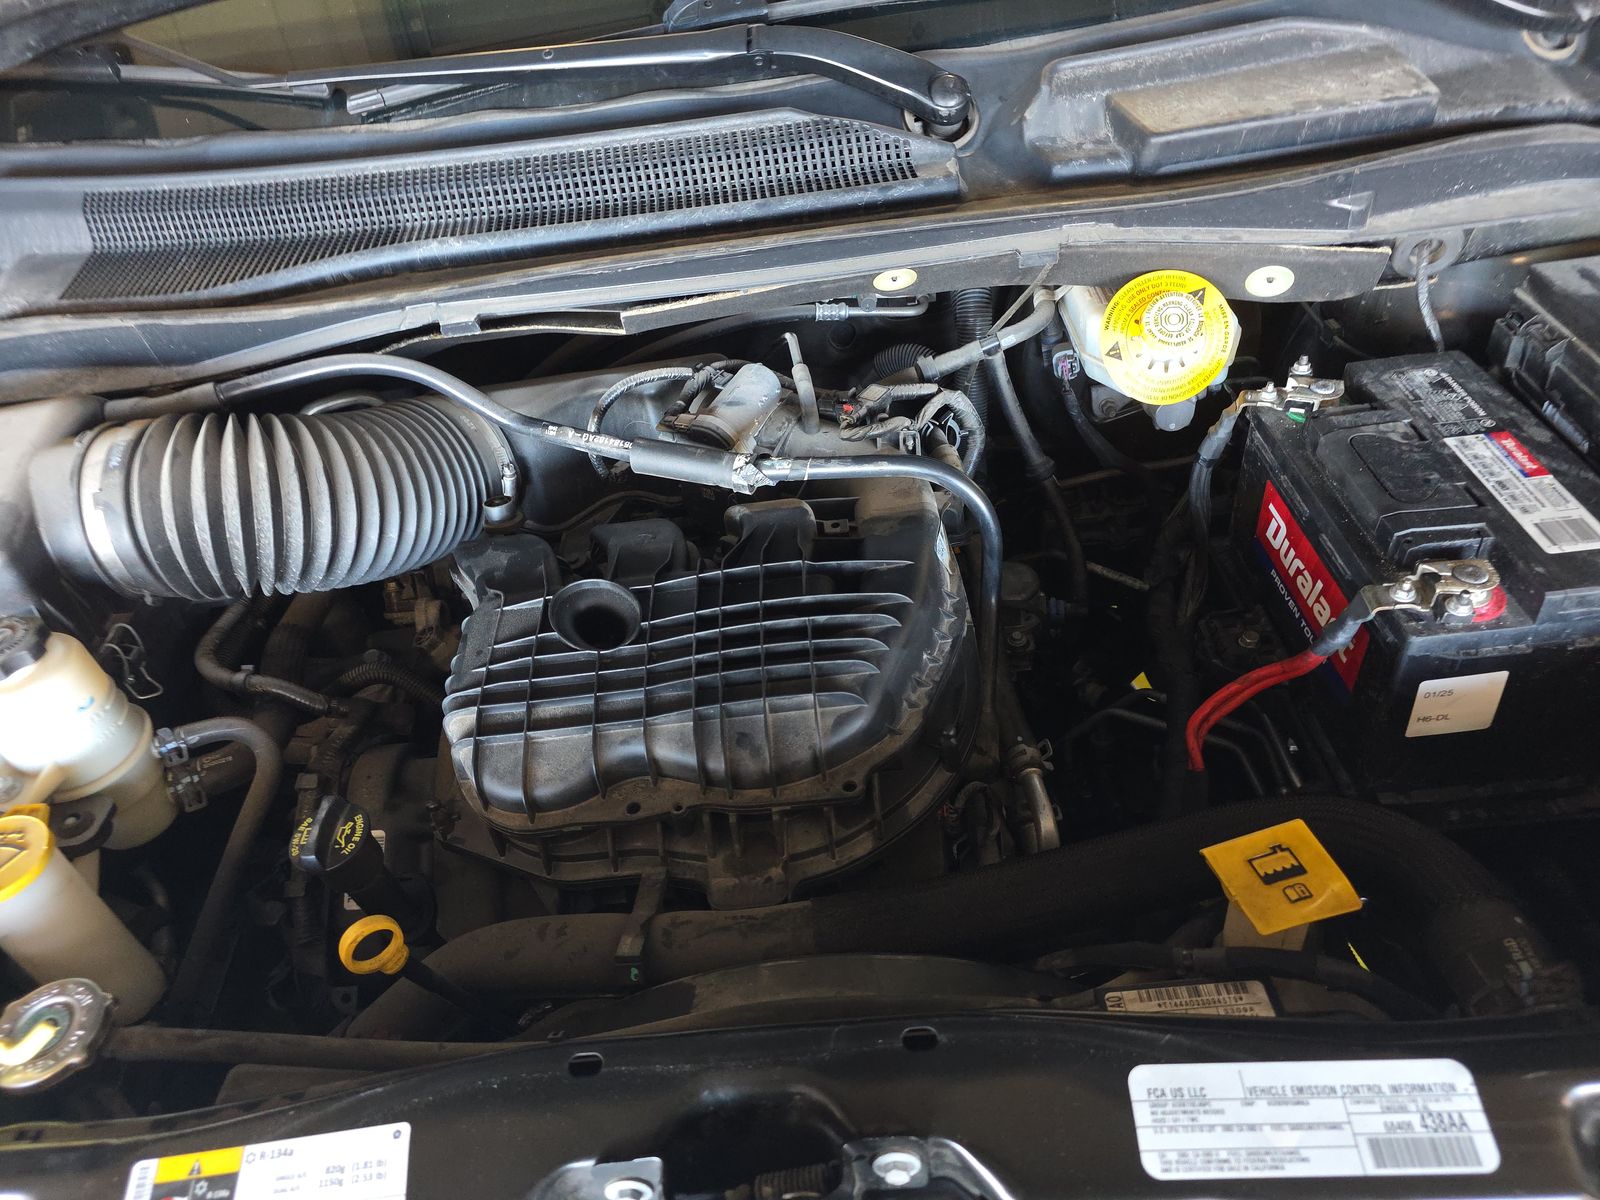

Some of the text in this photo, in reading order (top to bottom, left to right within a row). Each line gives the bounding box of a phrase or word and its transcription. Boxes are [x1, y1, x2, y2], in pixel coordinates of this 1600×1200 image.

[1136, 285, 1151, 296] ONLY
[1130, 296, 1147, 314] SEALED
[1218, 304, 1226, 320] MISE
[1104, 301, 1120, 330] WARNING:
[1270, 569, 1300, 618] PROVEN
[340, 814, 364, 855] ENGINE OIL
[1147, 1082, 1456, 1098] FCA US LLC VEHICLE EMISSION CONTROL INFORMATION
[1420, 1112, 1472, 1133] 438AA
[259, 1148, 294, 1160] R-134a
